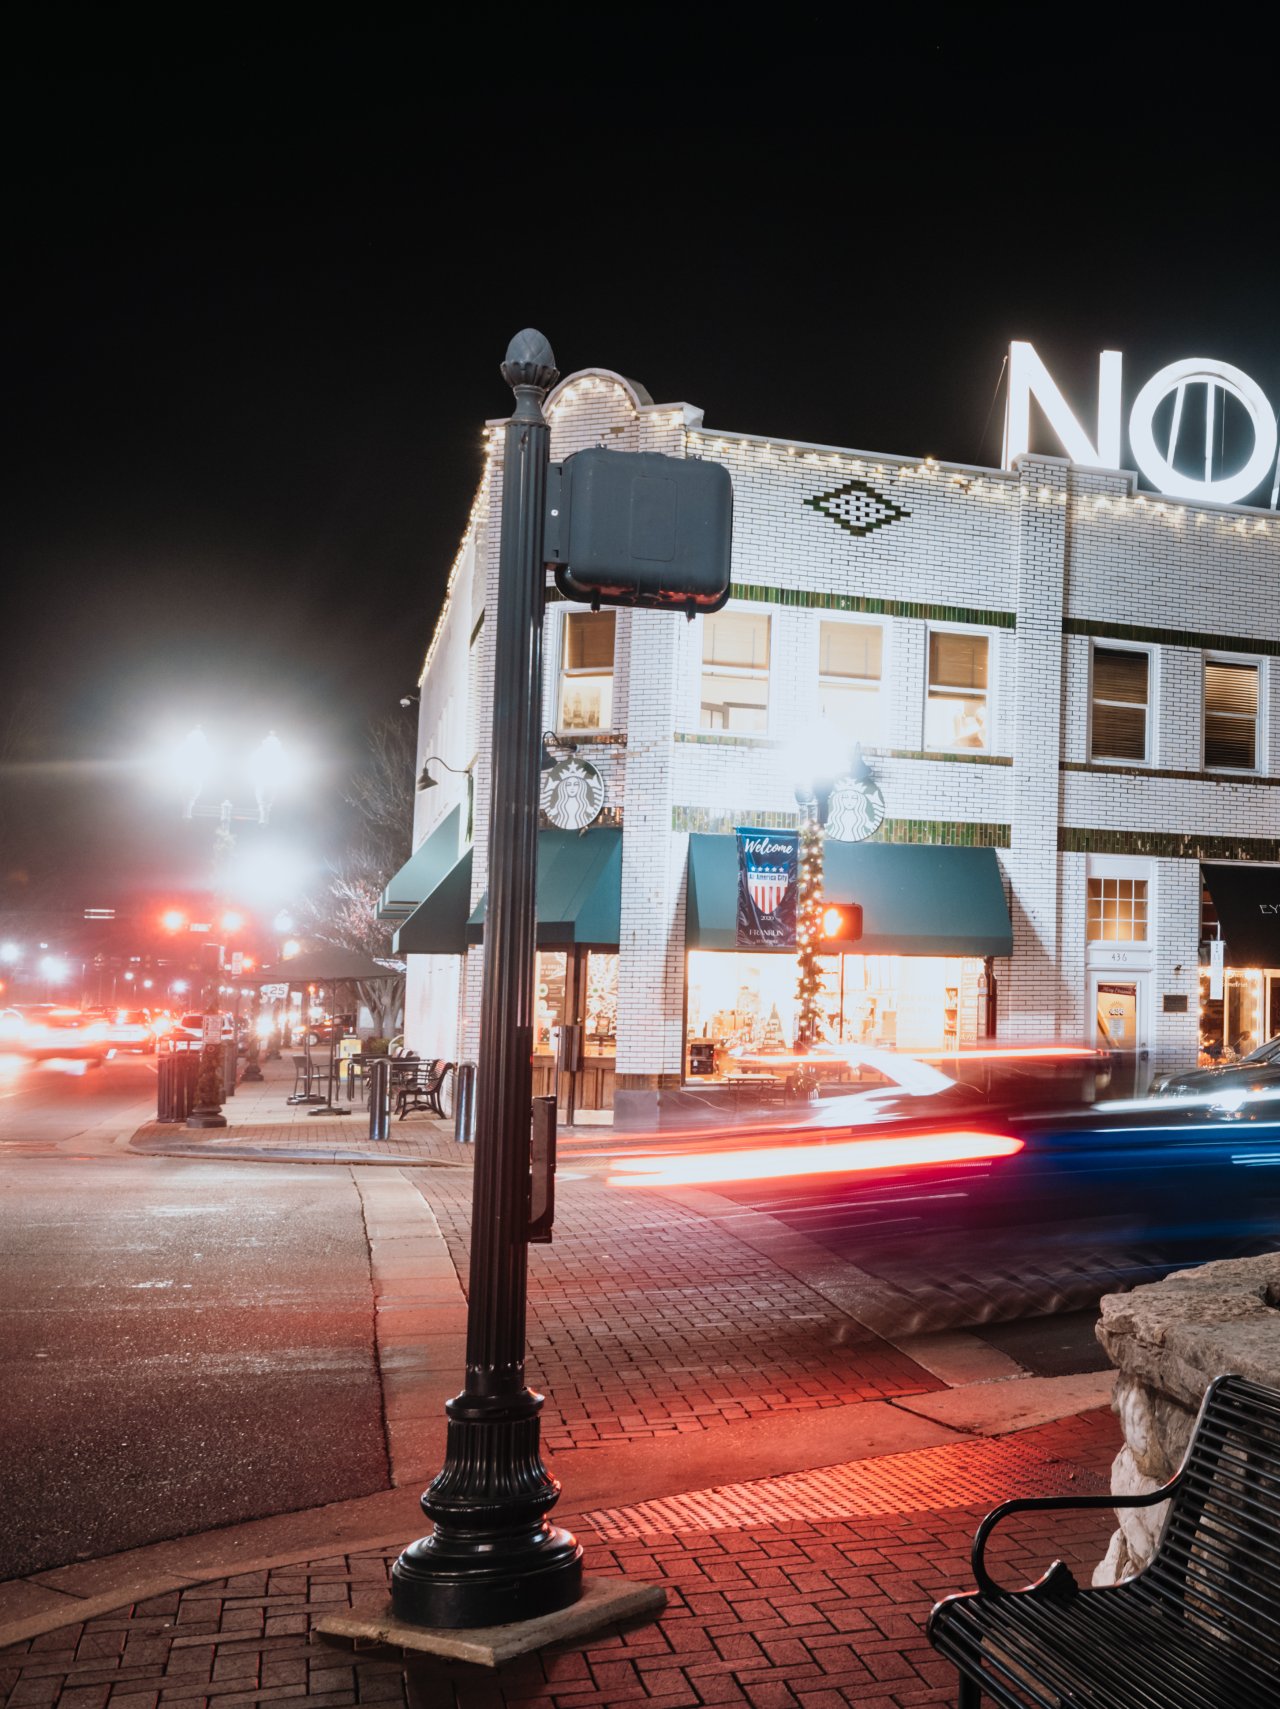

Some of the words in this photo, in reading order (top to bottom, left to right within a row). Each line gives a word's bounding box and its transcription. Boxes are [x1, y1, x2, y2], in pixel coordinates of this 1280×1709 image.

[745, 837, 793, 855] Welcome
[1111, 953, 1127, 961] 436
[270, 986, 285, 995] 25
